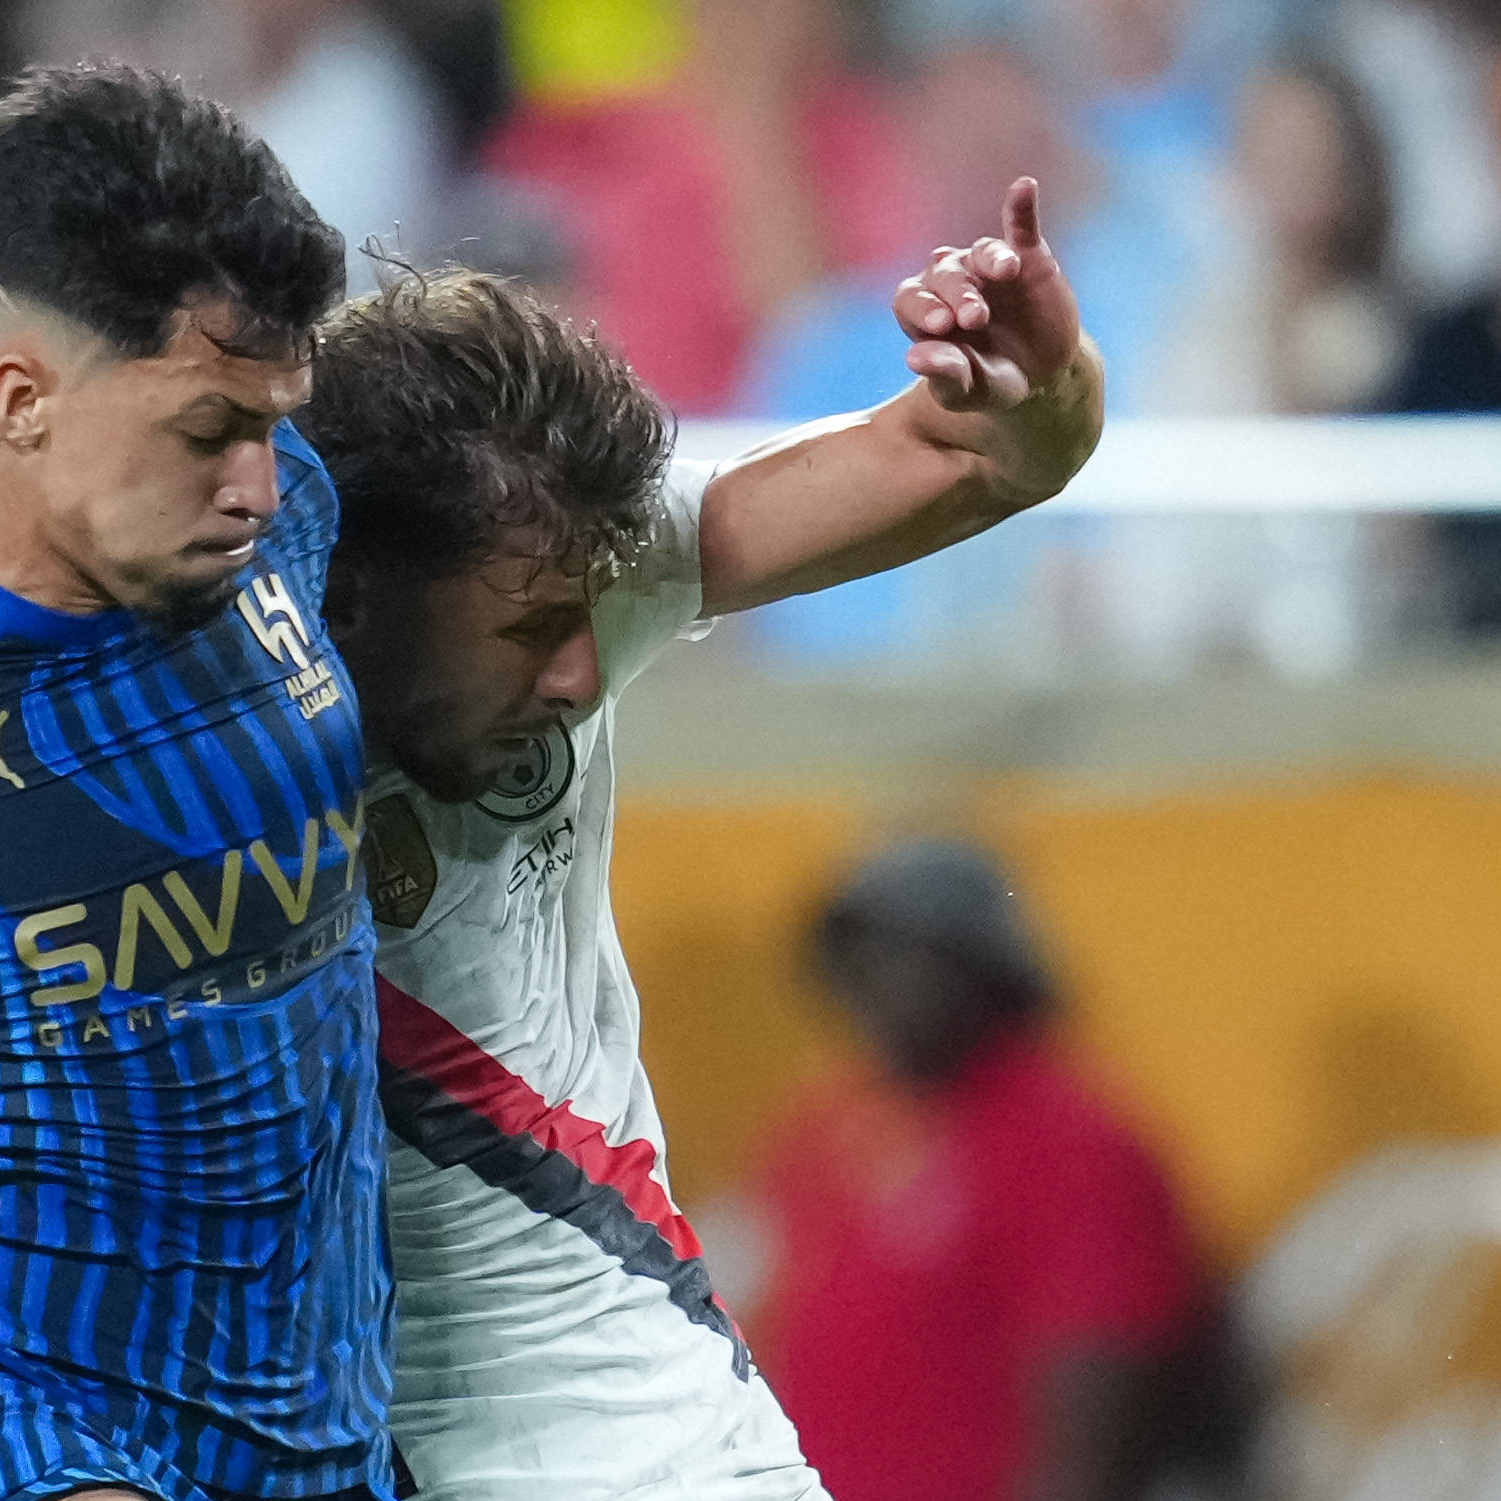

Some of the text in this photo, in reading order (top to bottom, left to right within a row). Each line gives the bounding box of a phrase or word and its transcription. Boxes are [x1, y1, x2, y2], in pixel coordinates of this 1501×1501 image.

[525, 783, 555, 810] CITY
[14, 790, 365, 1006] SAVVY
[507, 817, 575, 895] ETIH
[38, 908, 351, 1047] GAMES GROU
